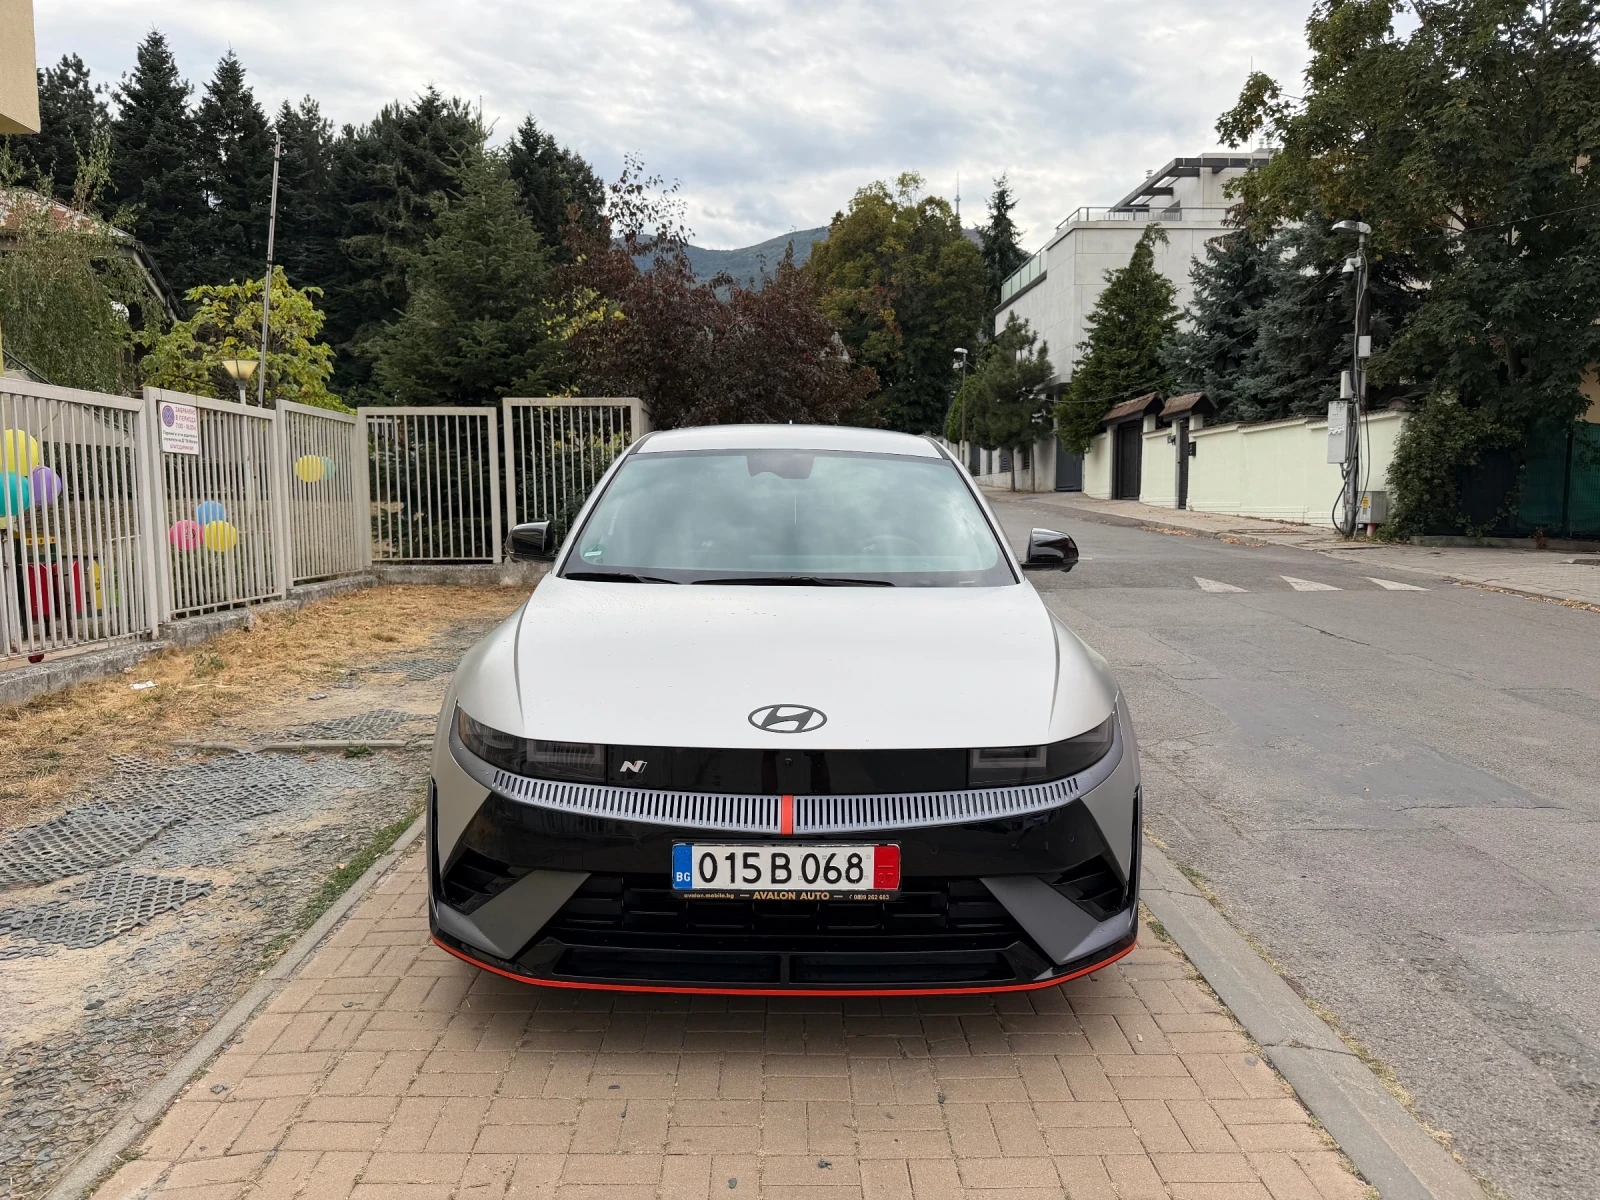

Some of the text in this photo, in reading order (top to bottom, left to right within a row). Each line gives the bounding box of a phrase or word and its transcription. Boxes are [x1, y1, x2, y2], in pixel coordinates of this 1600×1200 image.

[676, 872, 691, 882] BG
[752, 891, 796, 900] AVALON
[800, 891, 830, 900] AUTO
